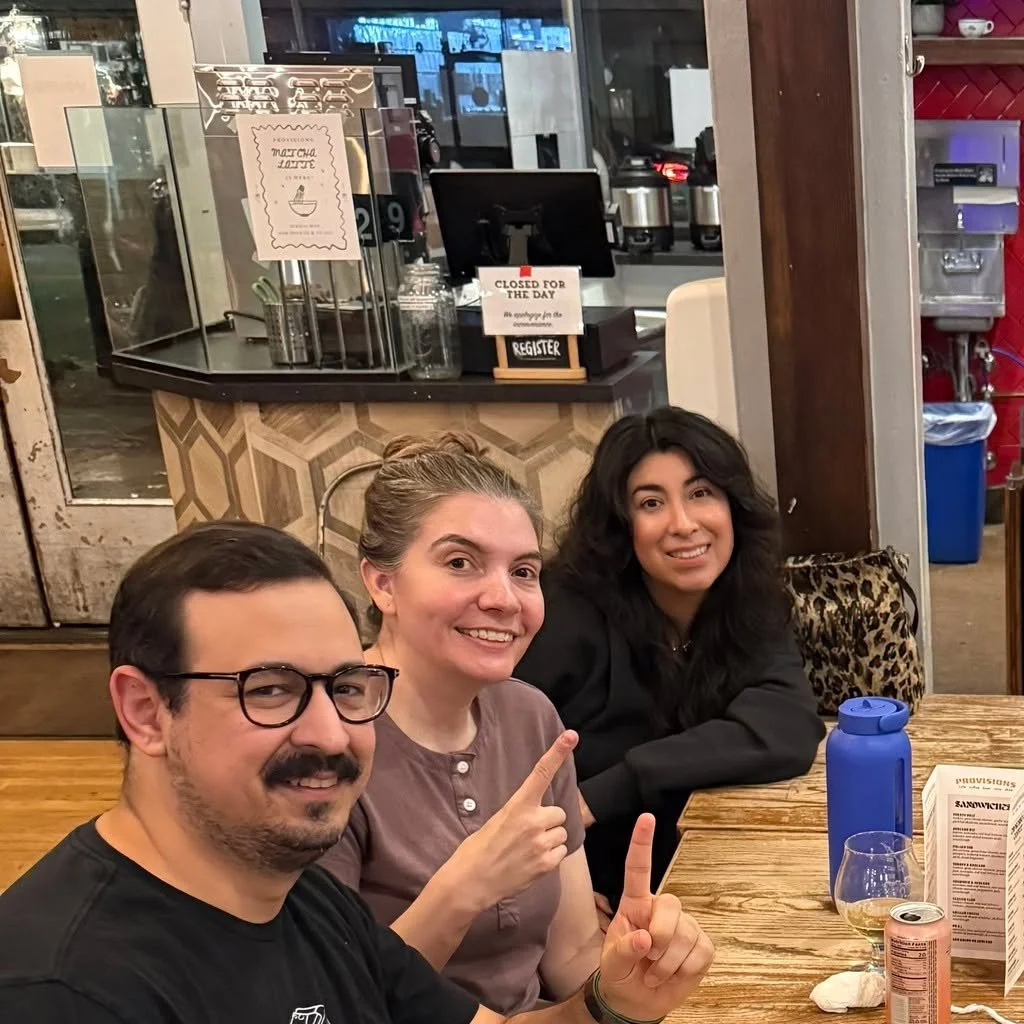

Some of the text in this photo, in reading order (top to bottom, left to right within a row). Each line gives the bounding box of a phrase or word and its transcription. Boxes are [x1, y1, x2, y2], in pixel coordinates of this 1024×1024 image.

[271, 147, 317, 158] MATCHA
[277, 159, 316, 169] LATTE
[388, 201, 405, 233] 9
[494, 280, 566, 289] CLOSED FOR
[507, 290, 556, 299] THE DAY
[511, 339, 561, 357] REGISTER
[955, 777, 1017, 788] PROVISIONS
